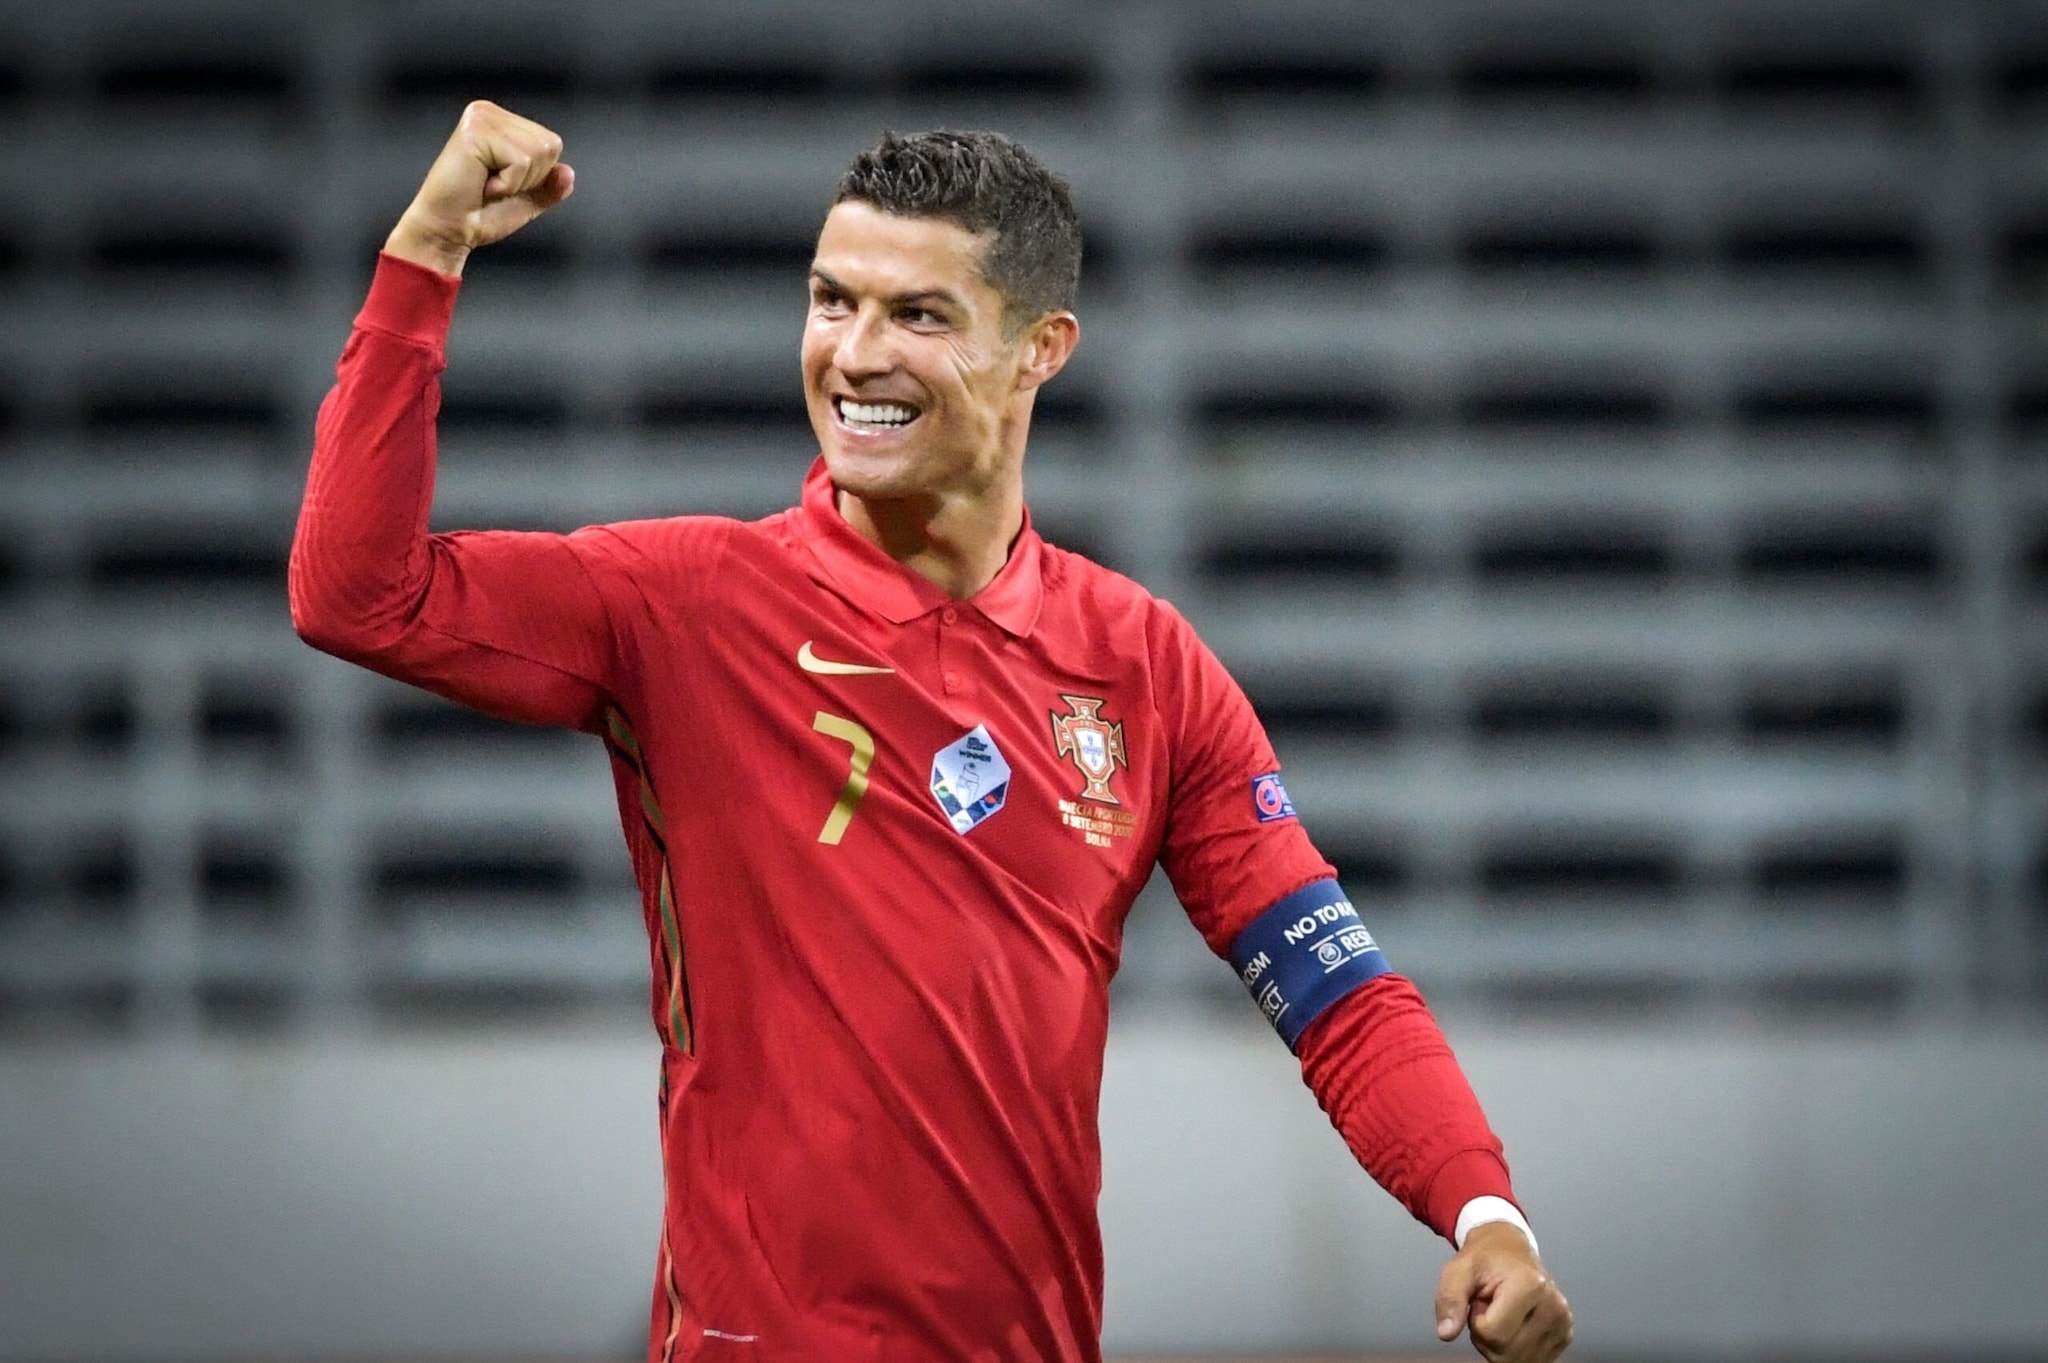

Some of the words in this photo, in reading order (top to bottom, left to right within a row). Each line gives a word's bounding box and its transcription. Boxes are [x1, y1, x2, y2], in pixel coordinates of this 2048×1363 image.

[813, 711, 875, 845] 7
[959, 750, 991, 762] WINNER
[1283, 916, 1317, 945] NO
[1313, 905, 1339, 925] TO
[1335, 901, 1358, 917] RA
